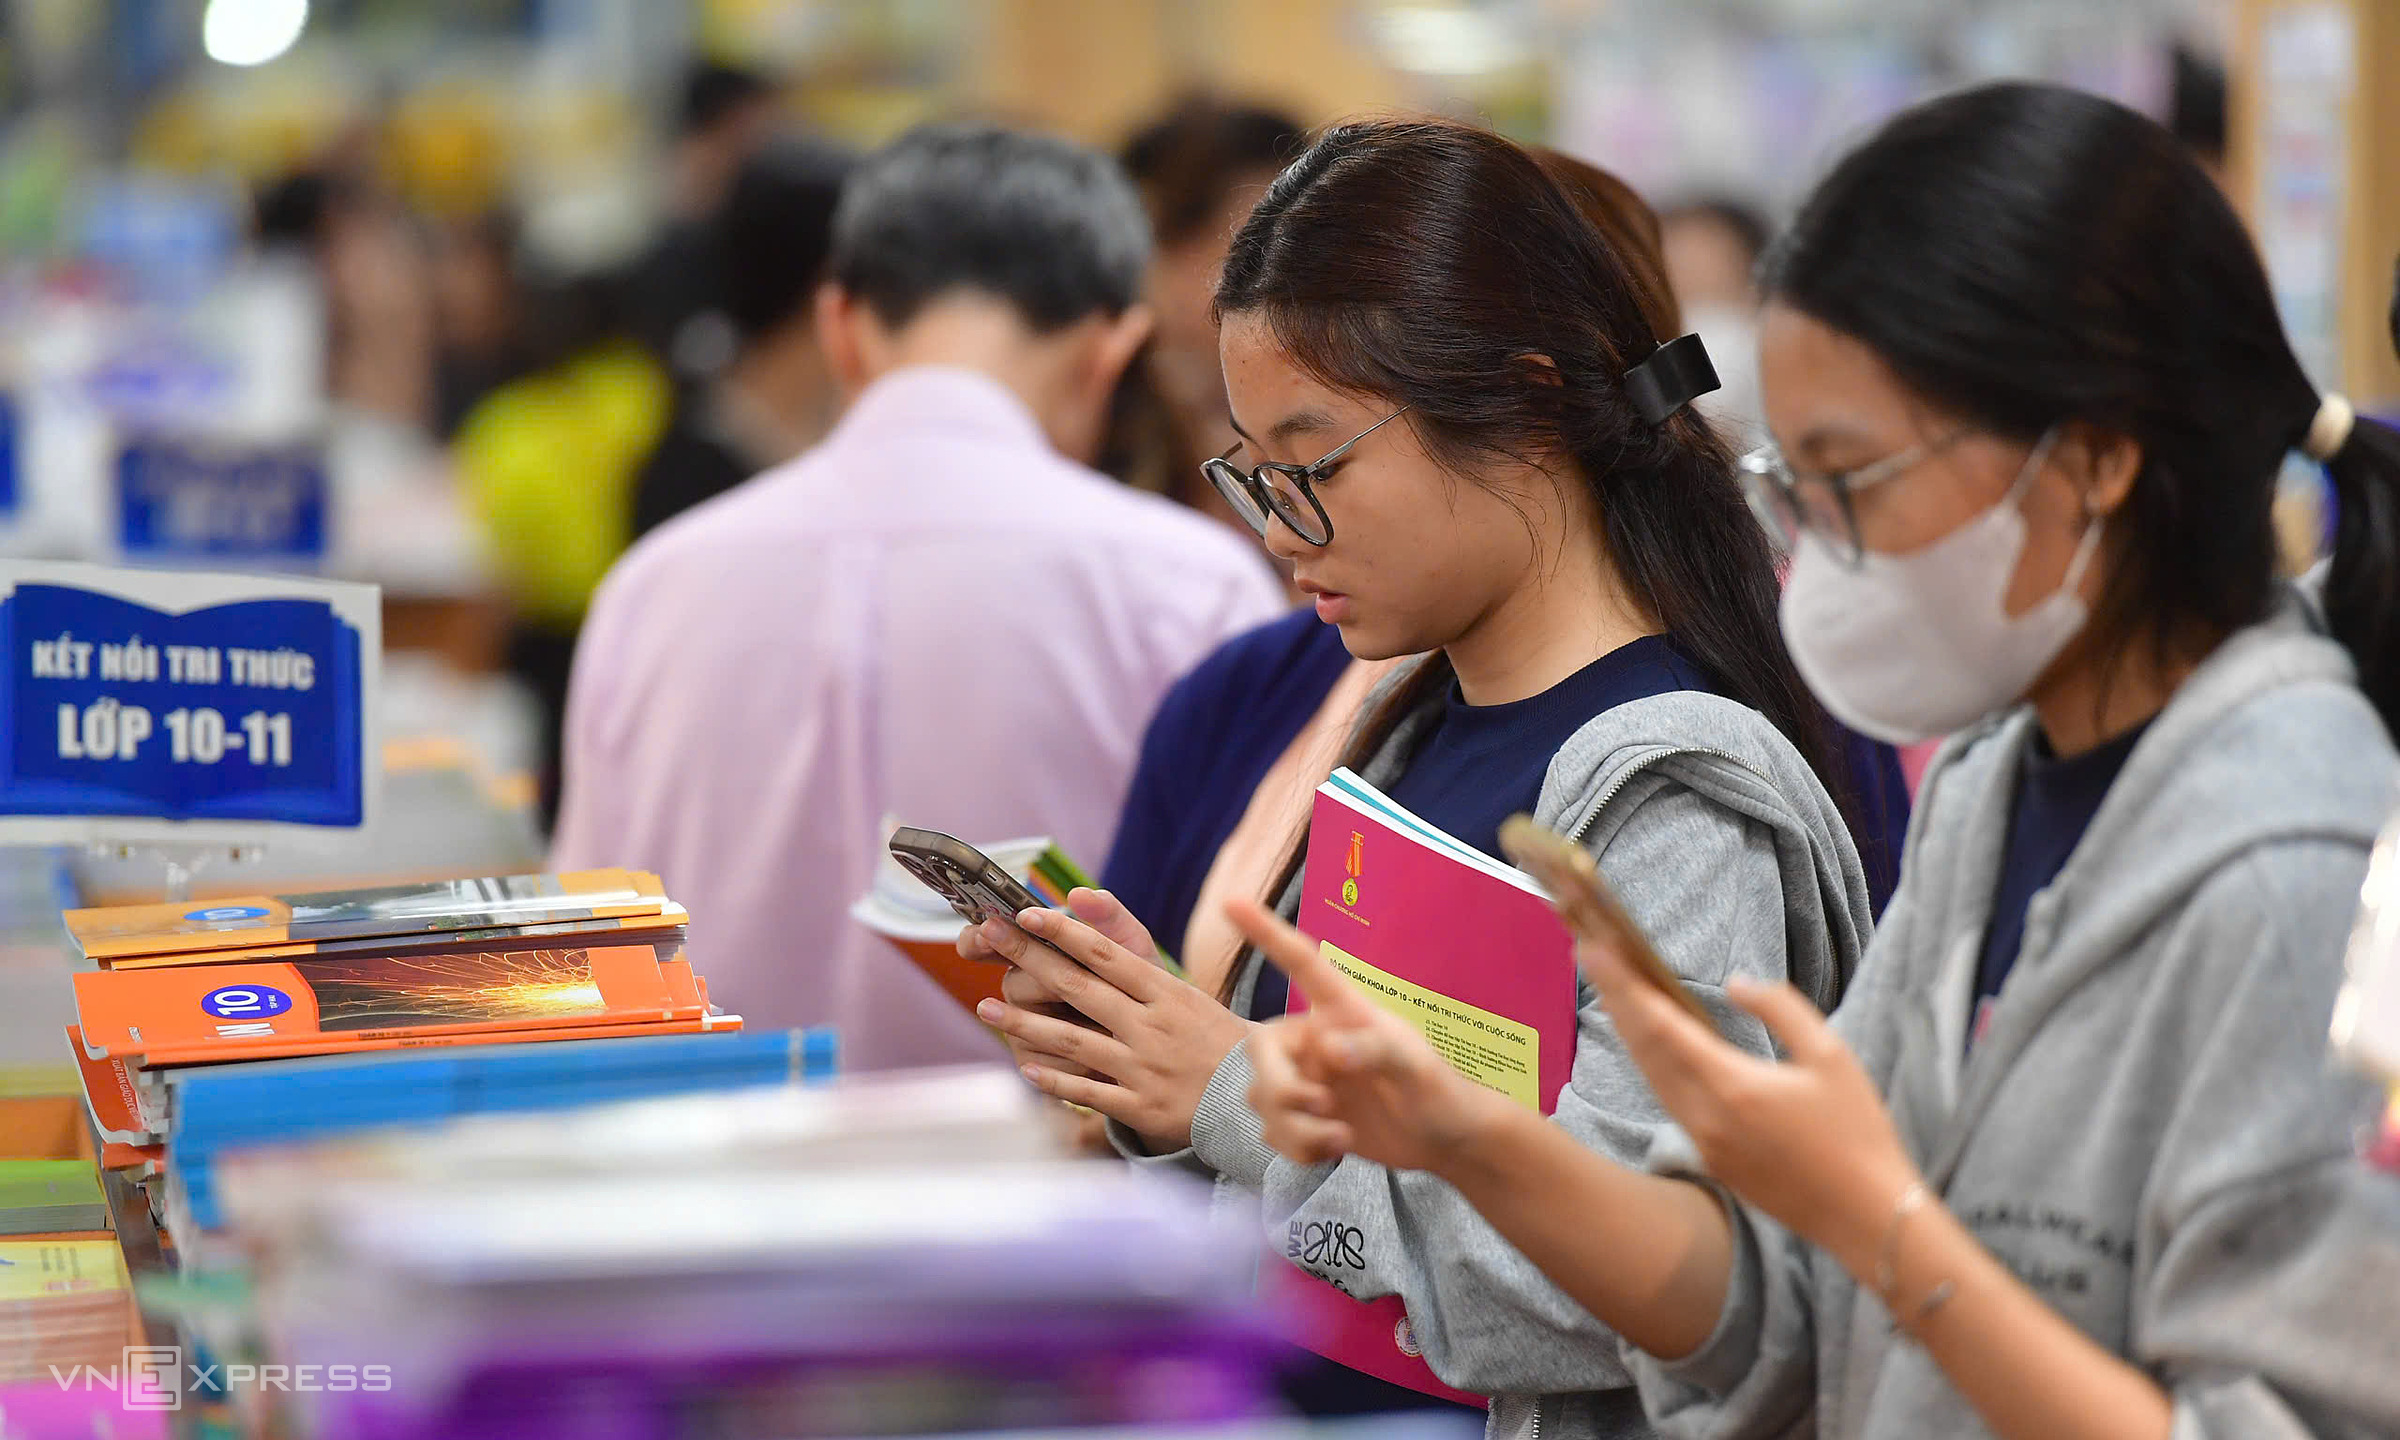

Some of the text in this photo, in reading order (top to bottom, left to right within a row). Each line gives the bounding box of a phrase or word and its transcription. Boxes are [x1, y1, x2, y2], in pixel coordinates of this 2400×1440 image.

[32, 631, 315, 691] KẾT NỐI TRI THỨC
[58, 695, 292, 767] LỚP 10-11
[213, 990, 262, 1016] 10
[1351, 971, 1367, 984] GIÁO
[1367, 978, 1385, 993] KHOA
[1385, 986, 1398, 997] LỚP
[1399, 992, 1407, 1001] 10
[1413, 997, 1426, 1008] KẾT
[1426, 1002, 1440, 1013] NỐI
[1440, 1007, 1452, 1018] TRI
[1452, 1011, 1471, 1026] THỨC
[1472, 1019, 1485, 1030] VỚI
[1485, 1024, 1505, 1038] CUỘC
[1506, 1031, 1526, 1046] SỐNG
[1288, 1220, 1303, 1258] WE
